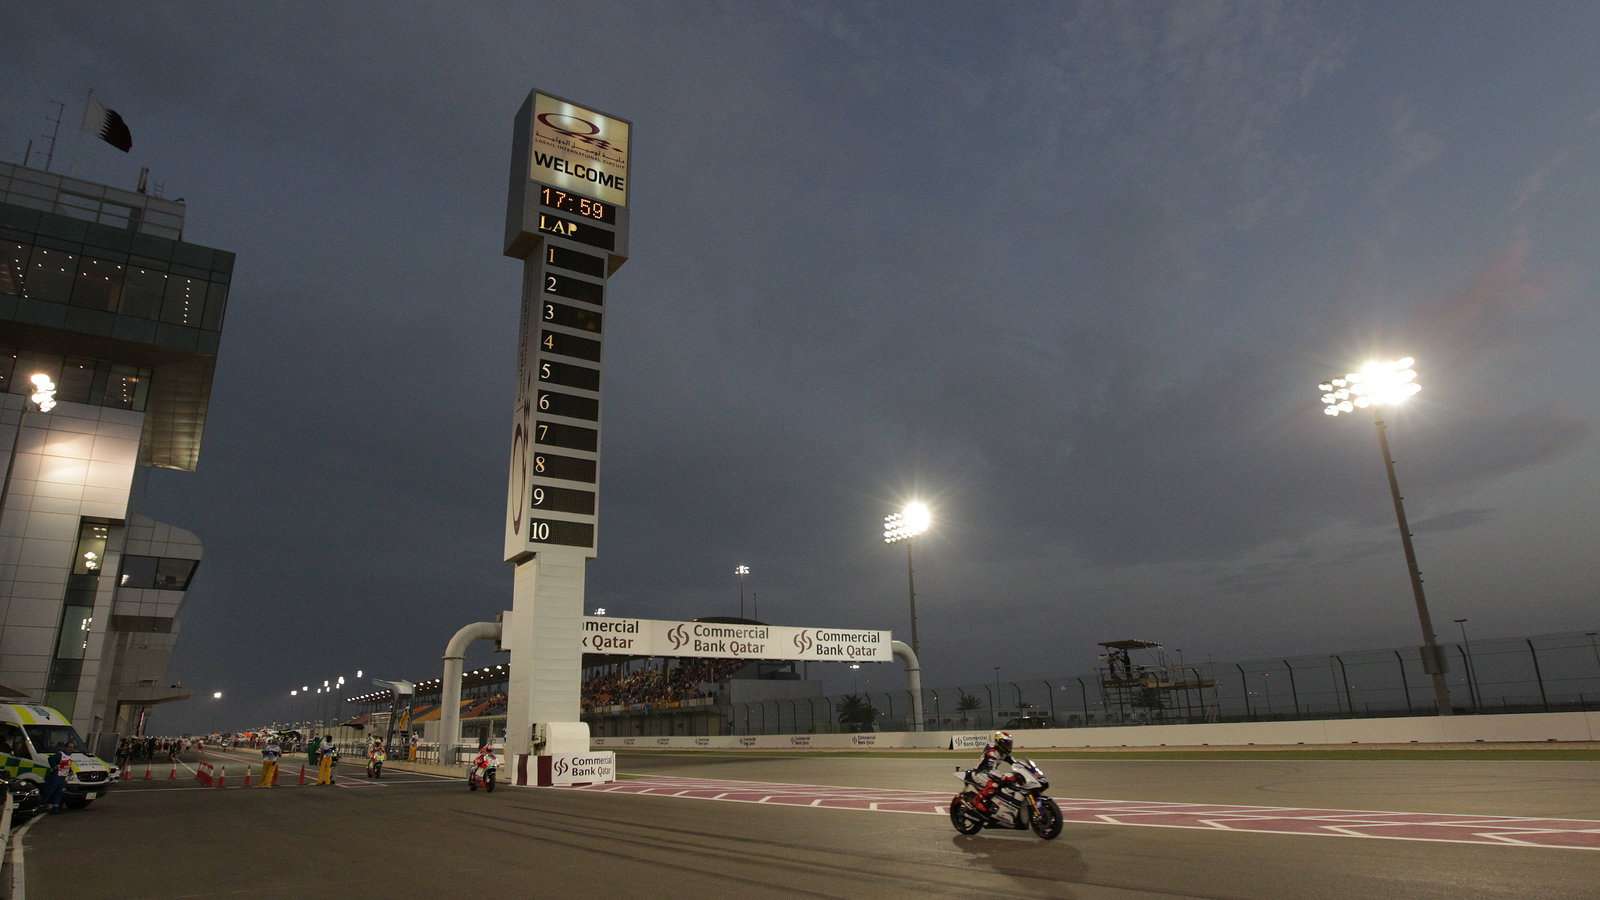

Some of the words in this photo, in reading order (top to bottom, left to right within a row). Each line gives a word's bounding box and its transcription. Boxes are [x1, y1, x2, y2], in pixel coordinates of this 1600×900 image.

[557, 145, 602, 162] INTERNATIONAL
[602, 159, 625, 169] CIRCUIT
[534, 150, 625, 191] WELCOME
[542, 188, 603, 219] 17:59
[539, 215, 578, 237] LAP
[549, 248, 555, 263] 1
[547, 276, 557, 292] 2
[544, 304, 554, 320] 3
[543, 334, 554, 350] 4
[541, 363, 551, 379] 5
[539, 394, 550, 410] 6
[538, 424, 548, 441] 7
[535, 456, 545, 473] 8
[533, 488, 544, 506] 9
[531, 522, 549, 540] 10
[582, 620, 639, 634] mercial
[693, 624, 769, 640] Commercial
[592, 634, 634, 651] Qatar
[815, 630, 880, 643] Commercial
[694, 640, 726, 653] Bank
[729, 641, 765, 656] Qatar
[816, 644, 844, 656] Bank
[846, 645, 877, 657] Qatar
[571, 756, 612, 766] Commercial
[572, 766, 596, 776] Bank
[597, 766, 611, 777] Qatar
